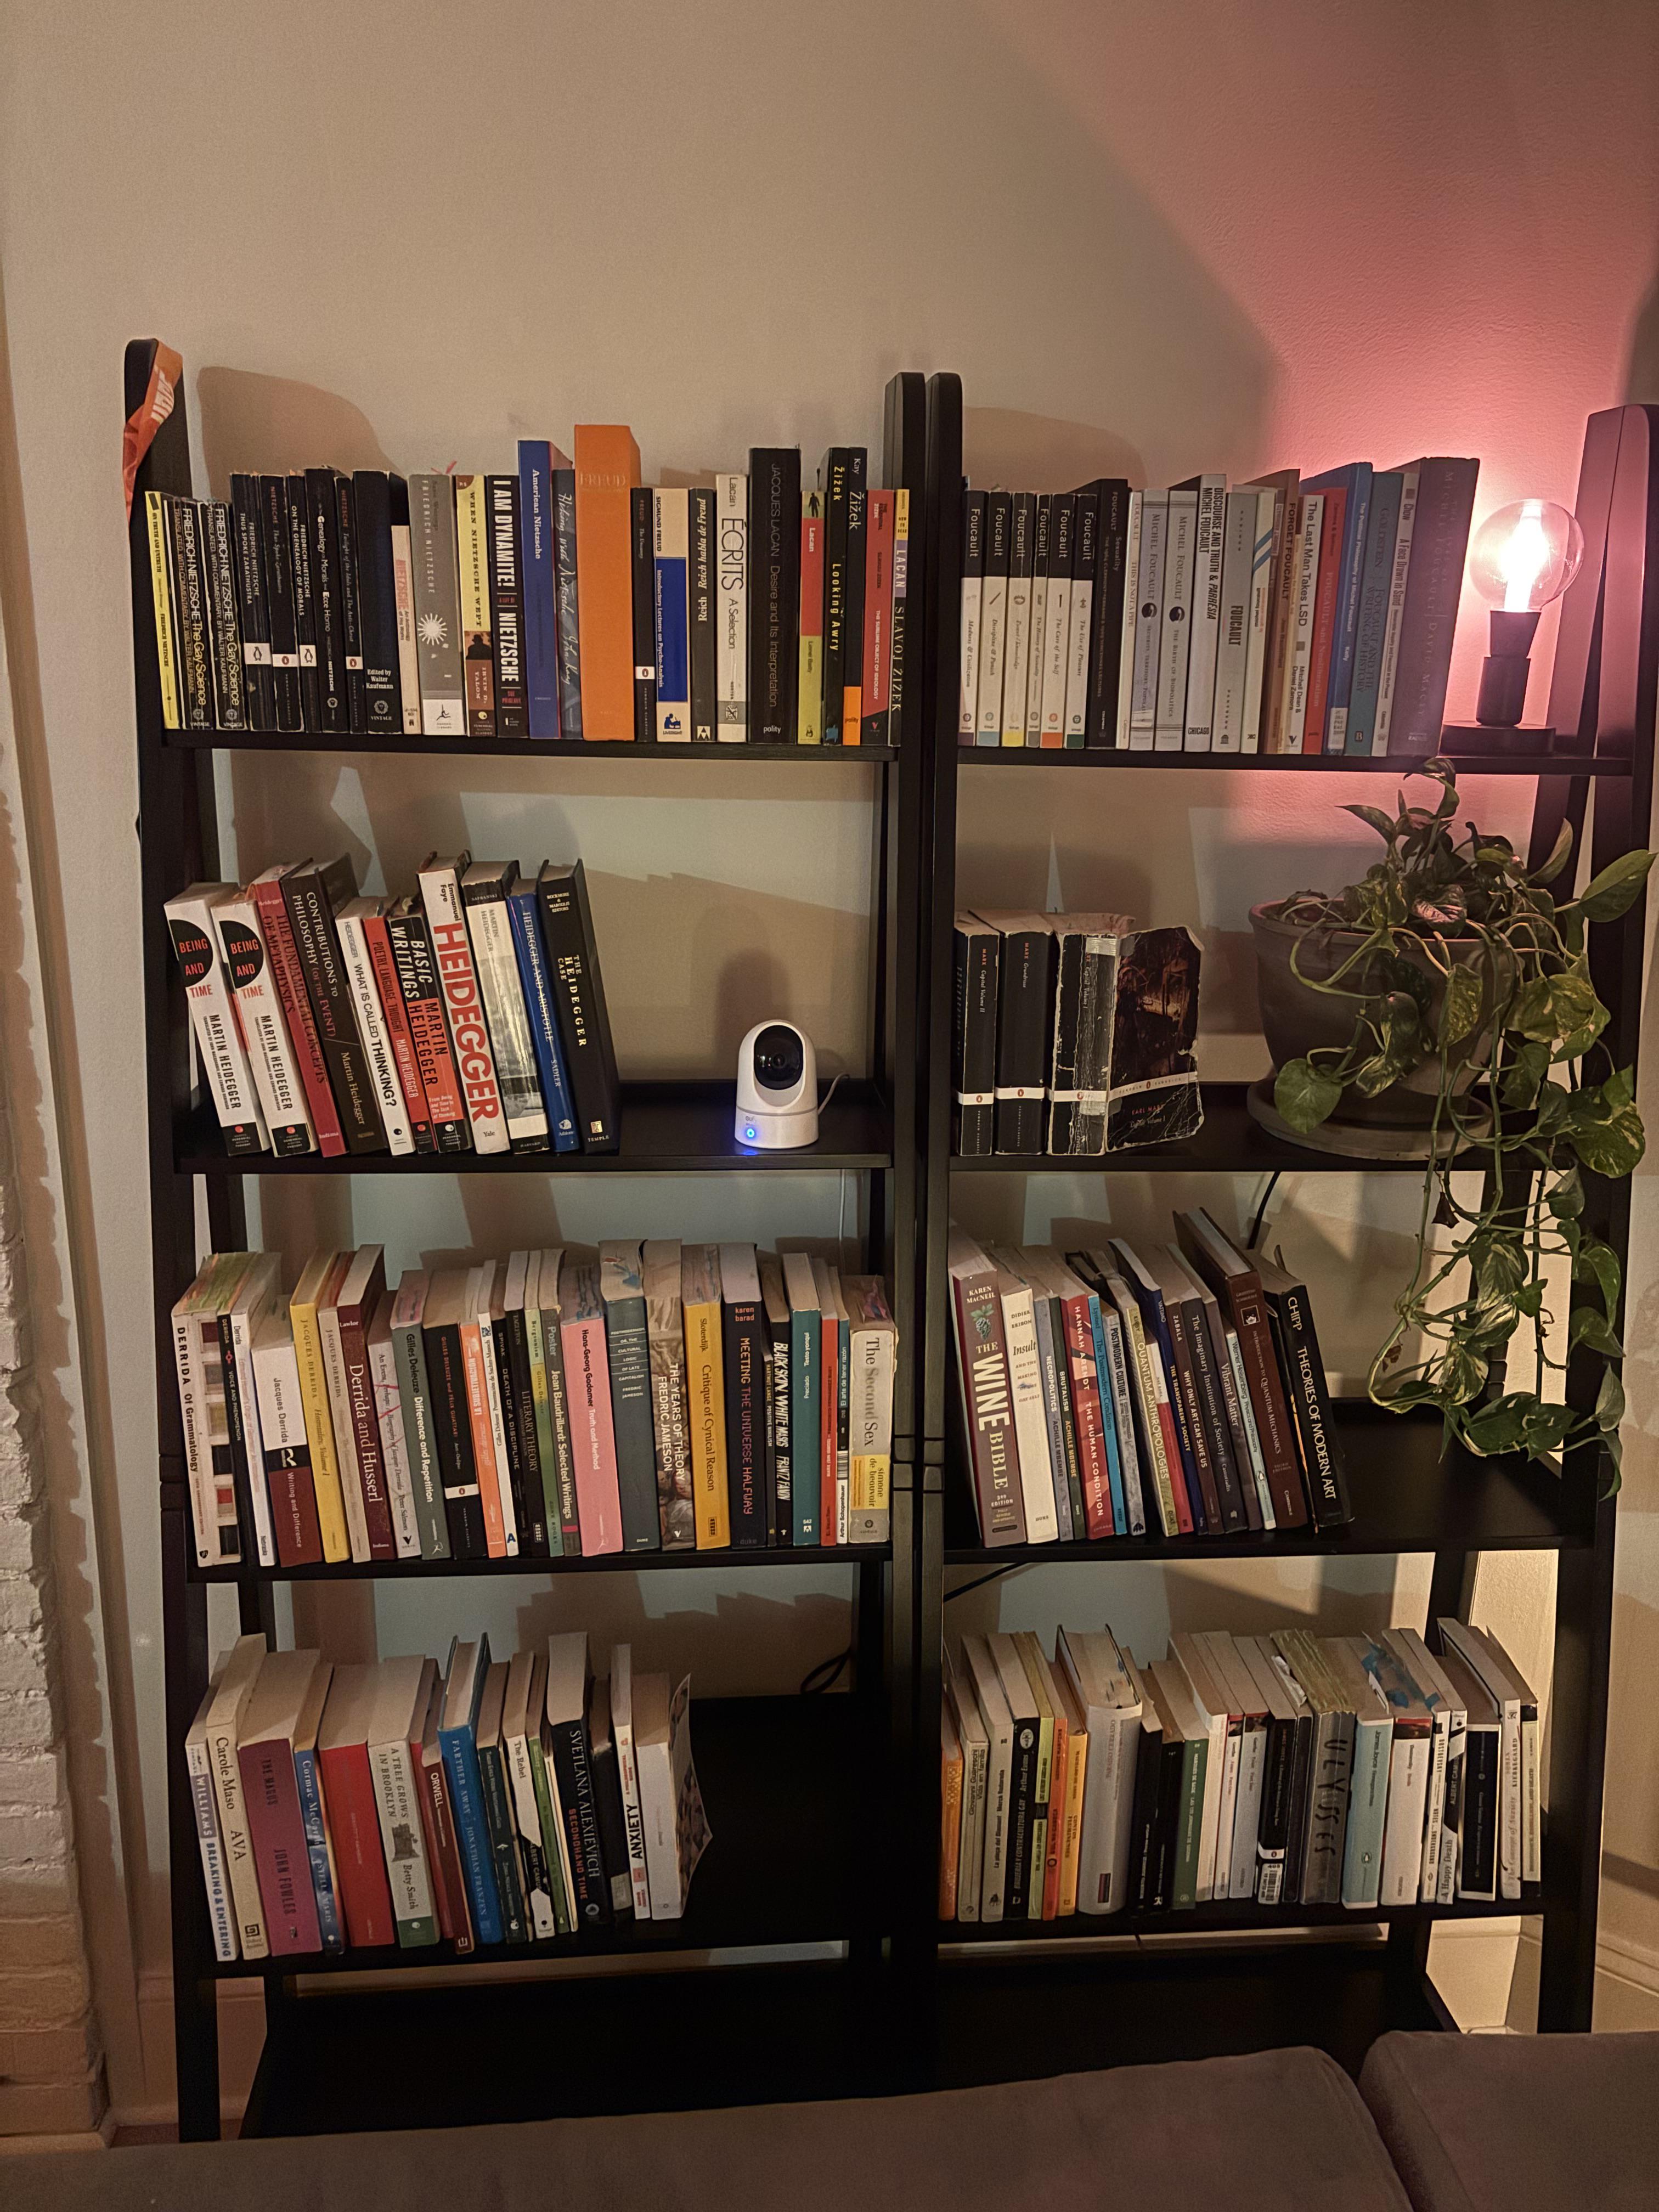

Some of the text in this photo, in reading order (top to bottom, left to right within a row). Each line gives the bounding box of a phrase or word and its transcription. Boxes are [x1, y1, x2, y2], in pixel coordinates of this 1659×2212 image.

[495, 490, 510, 511] AM
[533, 469, 543, 559] American Nietzsche
[729, 478, 739, 506] Lacan
[849, 458, 864, 529] Kay Žižek
[1211, 488, 1223, 529] DISCOURSE
[969, 509, 980, 557] Foucault
[994, 507, 1005, 556] Foucault
[1016, 509, 1027, 557] Foucault
[1038, 509, 1048, 556] Foucault
[1059, 510, 1070, 557] Foucault
[1082, 512, 1094, 560] Foucault
[1199, 488, 1212, 554] MICHEL FOUCAULT
[1211, 532, 1221, 547] AND
[1285, 503, 1296, 545] FORGET
[496, 516, 516, 586] DYNAMITE!
[722, 518, 747, 590] ÉCRITS
[831, 466, 844, 651] Žižek Looking Awry
[1209, 549, 1220, 572] TRUTH
[1282, 548, 1294, 600] FOUCAULT
[1299, 501, 1317, 626] The Last Man Takes LSD
[242, 557, 252, 604] ZARATHUSTRA
[769, 464, 781, 707] JACQUES LACAN Desire and Its Interpretation
[215, 509, 240, 706] FRIEDRICH NIETZSCHE The Gay Science
[729, 608, 738, 649] Selection
[892, 550, 906, 712] LACAN SLAVOJ ŽIŽEK
[500, 613, 520, 681] NIETZSCHE
[440, 884, 449, 902] Faye
[448, 883, 461, 921] Emmanuel
[178, 941, 208, 953] BEING
[292, 895, 317, 964] PHILOSOPHY
[314, 983, 323, 997] THE
[306, 892, 338, 996] CONTRIBUTIONS TO
[391, 927, 419, 998] WRITINGS
[410, 940, 433, 983] BASIC
[573, 955, 582, 974] THE
[185, 964, 205, 975] AND
[189, 986, 213, 998] TIME
[558, 958, 567, 980] CASE
[433, 922, 499, 1122] HEIDEGGER
[565, 957, 586, 1046] HEIDEGGER
[354, 964, 396, 1107] WHAT IS CALLED THINKING?
[409, 1006, 438, 1086] HEIDEGGER
[425, 1002, 448, 1055] MARTIN
[209, 1014, 241, 1109] MARTIN HEIDEGGER
[341, 1052, 366, 1125] Martin Heidegger
[407, 1334, 416, 1357] Gilles
[582, 1330, 592, 1372] Hans-Georg
[1075, 1306, 1085, 1348] HANNAH
[409, 1359, 420, 1393] Deleuze
[774, 1342, 788, 1368] BLACK
[1080, 1352, 1089, 1390] ARENDT
[177, 1327, 199, 1472] DERRIDA Of Grammatology
[584, 1373, 595, 1407] Gadamer
[775, 1395, 788, 1425] WHITE
[865, 1338, 880, 1446] The Second Sex
[1287, 1297, 1336, 1499] CHIPP THEORIES OF MODERN ART
[349, 1364, 382, 1503] Derrida and Husserl
[414, 1397, 425, 1440] Difference
[588, 1409, 597, 1426] Truth
[658, 1376, 673, 1471] FREDRIC JAMESON
[669, 1363, 685, 1480] THE YEARS OF THEORY
[741, 1338, 753, 1514] MEETING THE UNIVERSE HALFWAY
[777, 1427, 789, 1447] MASKS
[973, 1344, 1010, 1489] THE WINE BIBLE
[1046, 1356, 1057, 1412] NECROPOLITICS
[1056, 1452, 1064, 1477] MBEMBE
[591, 1443, 600, 1470] Method
[1088, 1424, 1097, 1458] HUMAN
[421, 1459, 433, 1502] Repetition
[777, 1455, 789, 1479] FRANTZ
[777, 1481, 790, 1500] FANON
[1091, 1462, 1103, 1516] CONDITION
[379, 1754, 396, 1817] IN BROOKLYN
[392, 1758, 402, 1782] TREE
[430, 1773, 443, 1808] ORWELL
[216, 1737, 246, 1861] Carole Maso AVA
[396, 1786, 408, 1818] GROWS
[569, 1730, 600, 1877] SVETLANA ALEXIEVICH
[1314, 1739, 1348, 1856] ULYSSES
[568, 1808, 588, 1899] SECONDHAND TIME
[627, 1804, 643, 1859] ANXIETY
[196, 1776, 211, 1836] WILLIAMS
[206, 1843, 222, 1894] BREAKING
[215, 1907, 231, 1956] ENTERING
[403, 1865, 418, 1909] Betty Smith
